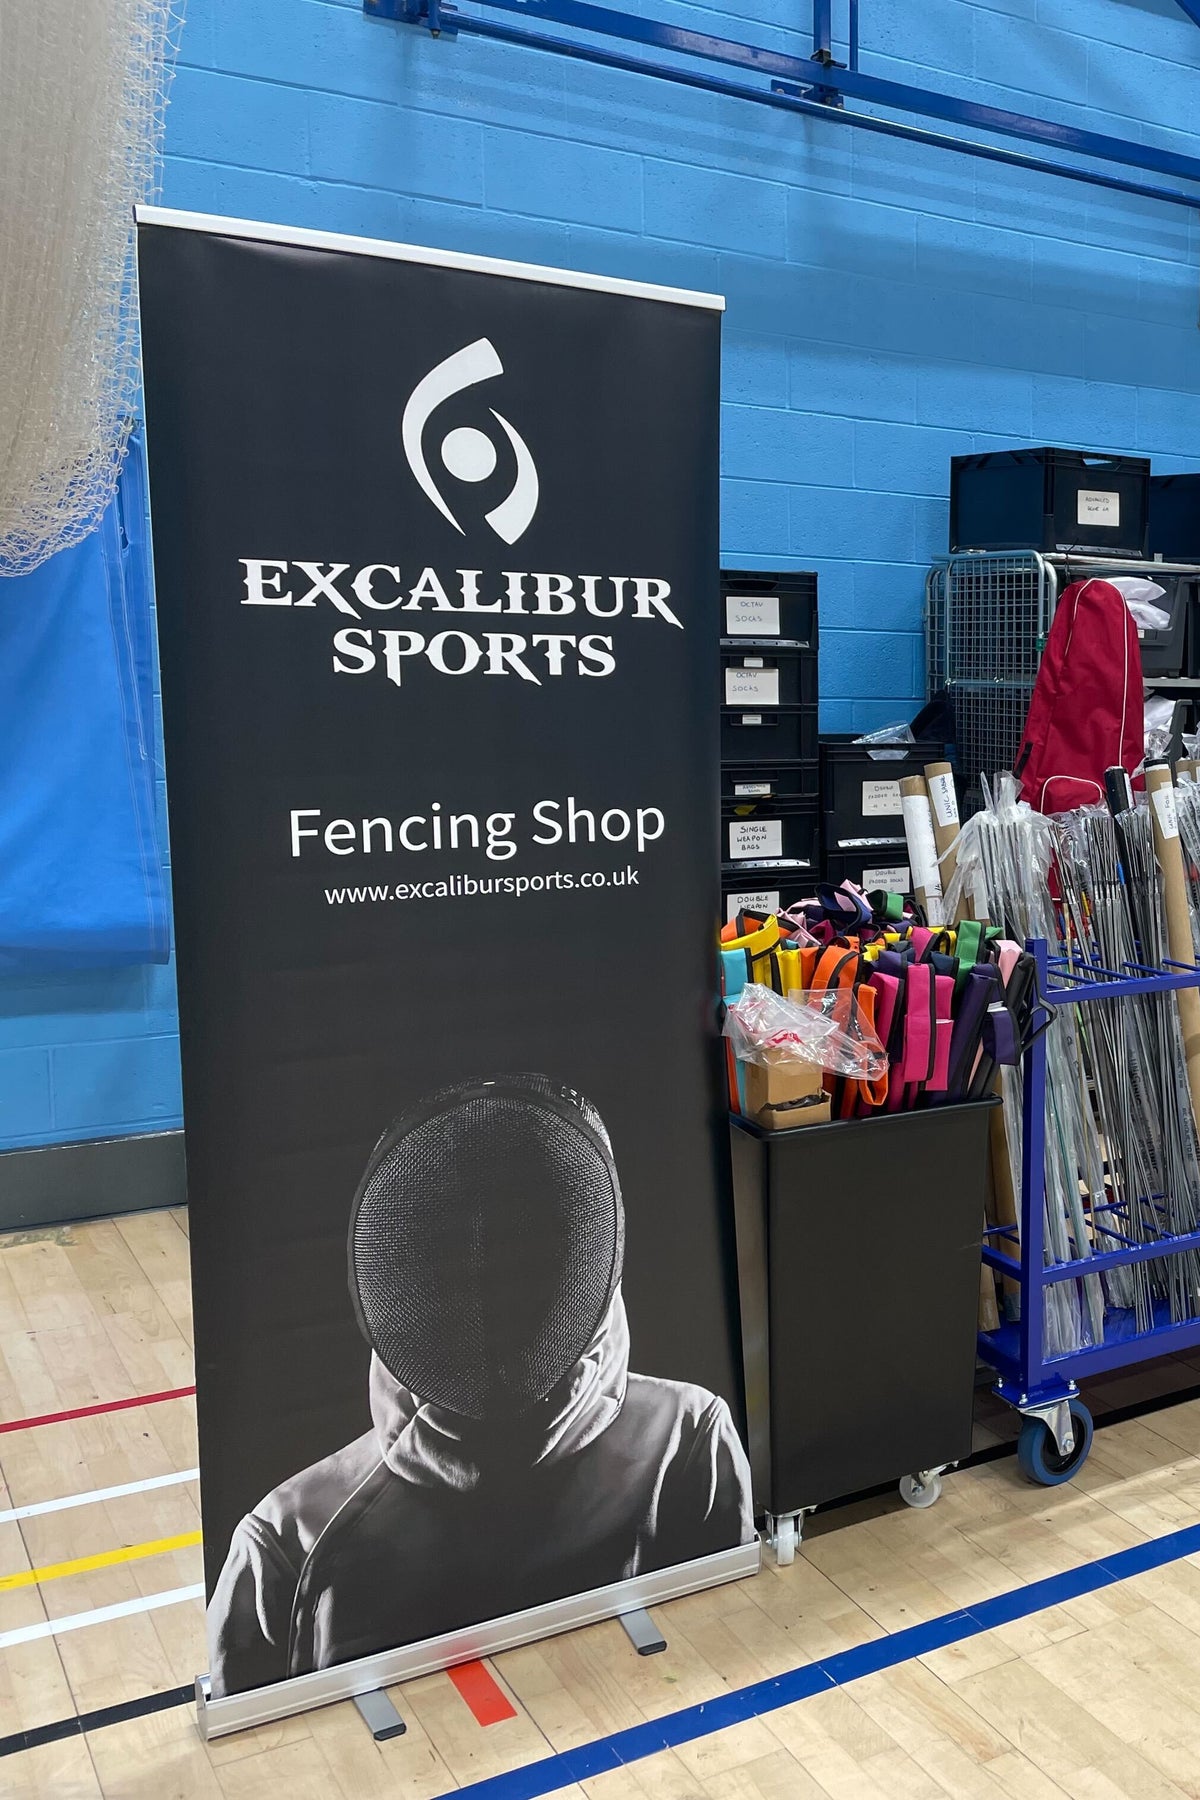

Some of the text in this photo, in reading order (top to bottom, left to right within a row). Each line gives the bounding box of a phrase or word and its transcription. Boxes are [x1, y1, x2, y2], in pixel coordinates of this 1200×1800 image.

[238, 558, 684, 629] EXCALIBUR
[332, 628, 617, 687] SPORTS
[289, 797, 666, 860] Fencing Shop
[736, 834, 767, 843] WEAPON
[739, 826, 768, 834] SINGLE
[324, 865, 640, 905] www.excalibursports.co.uk
[737, 894, 769, 904] DOUBLE
